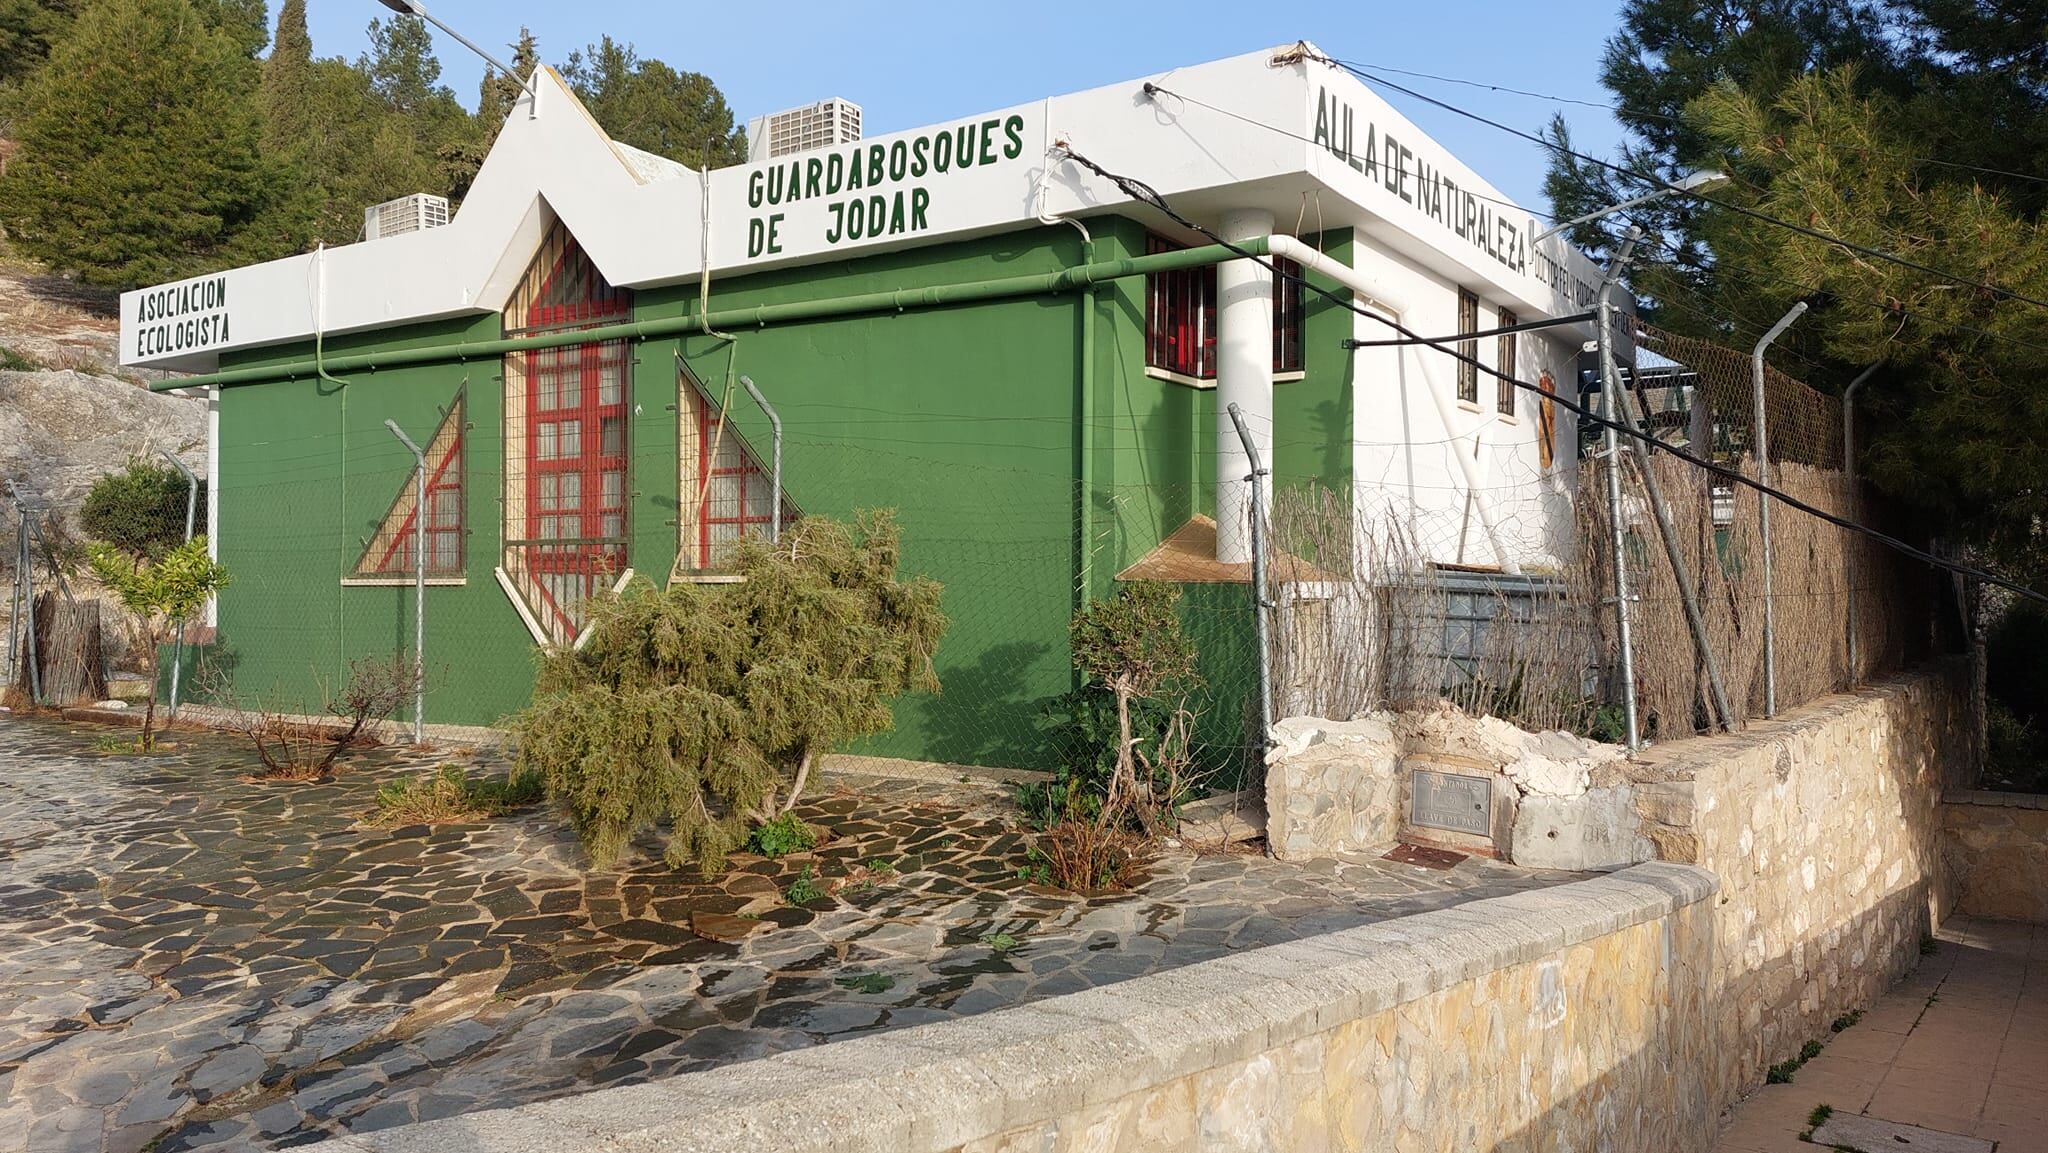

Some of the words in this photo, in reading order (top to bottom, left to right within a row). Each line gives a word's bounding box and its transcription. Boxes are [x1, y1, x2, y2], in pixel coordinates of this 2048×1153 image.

[748, 114, 1024, 209] GUARDABOSQUES
[1314, 85, 1378, 184] AULA
[1385, 133, 1412, 205] DE
[1417, 157, 1526, 277] NATURALEZA
[747, 213, 785, 258] DE
[826, 187, 930, 244] JODAR
[137, 312, 229, 357] ECOLOGISTA
[138, 277, 226, 324] ASOCIACION
